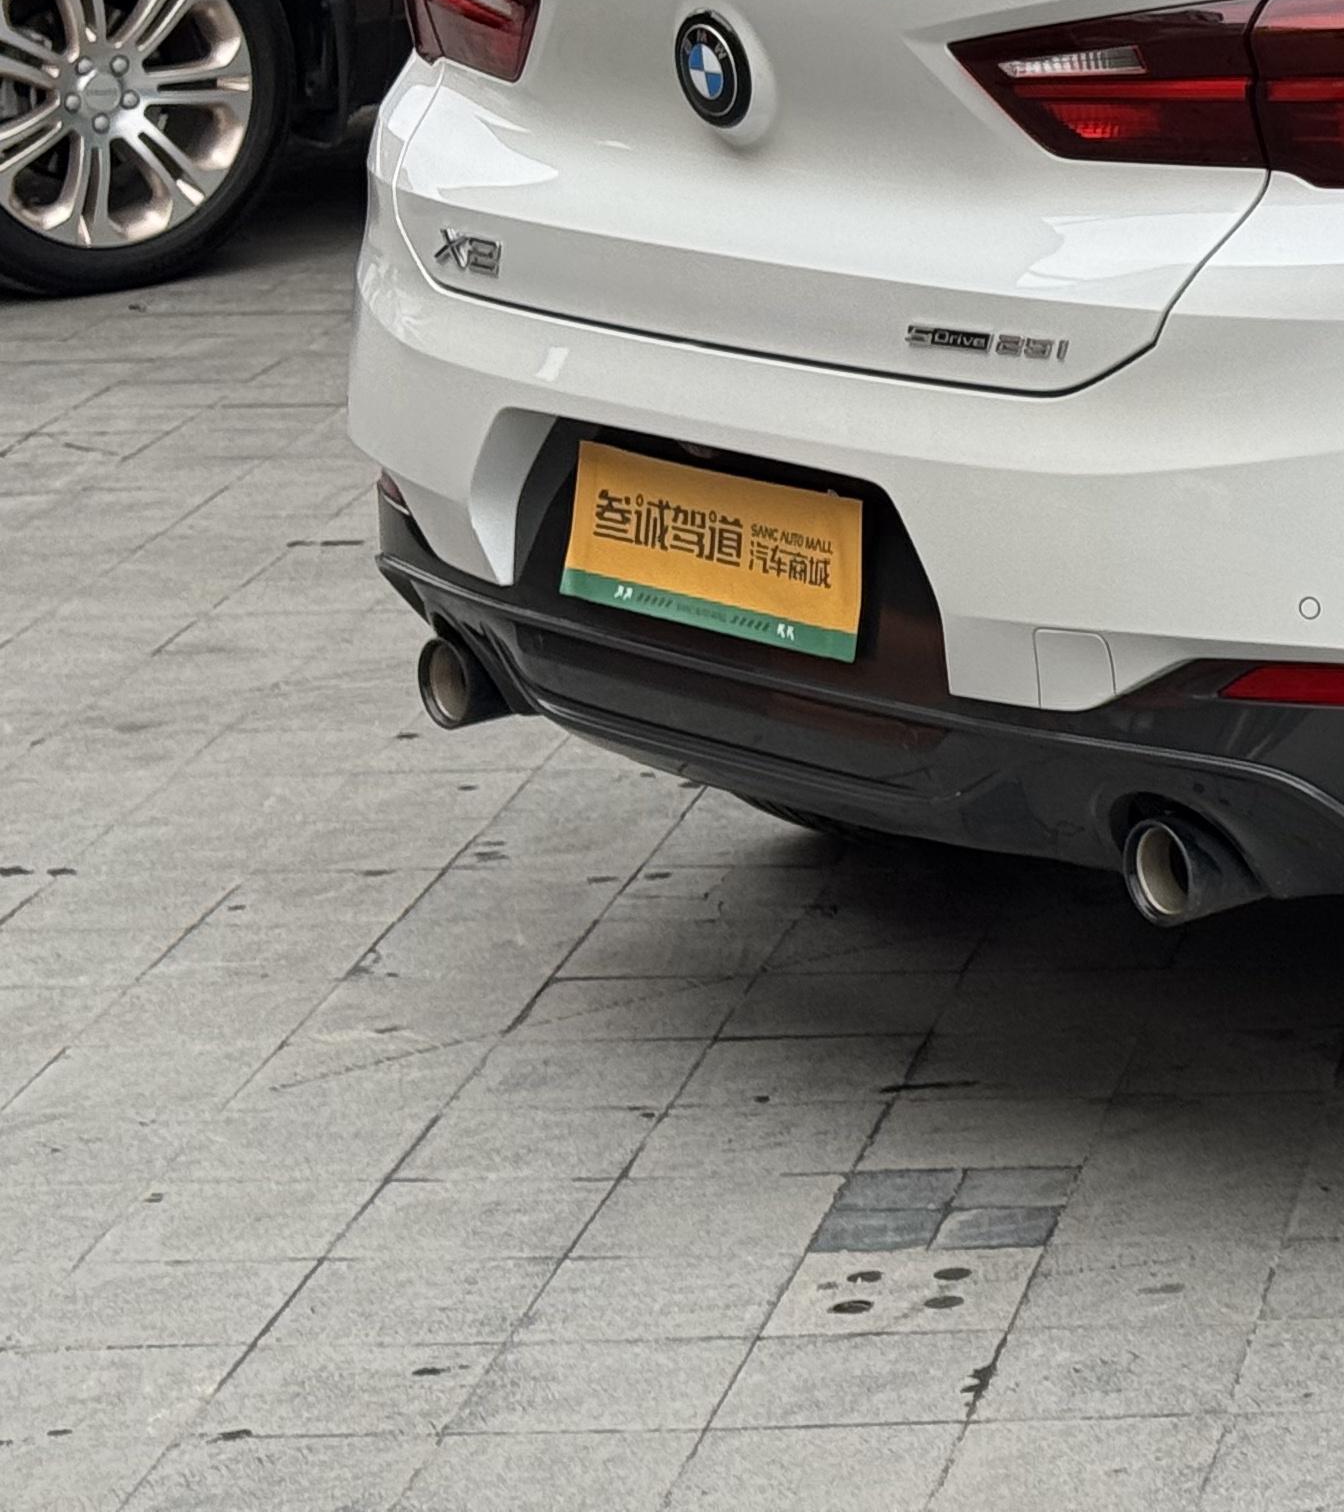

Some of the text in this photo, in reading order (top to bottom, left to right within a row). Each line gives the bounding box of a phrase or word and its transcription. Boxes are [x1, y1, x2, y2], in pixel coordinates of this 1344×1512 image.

[434, 228, 502, 278] X2
[593, 489, 743, 567] 叁诚驾道
[750, 522, 834, 556] SANC AUTO MALL
[749, 540, 832, 589] 汽车商城
